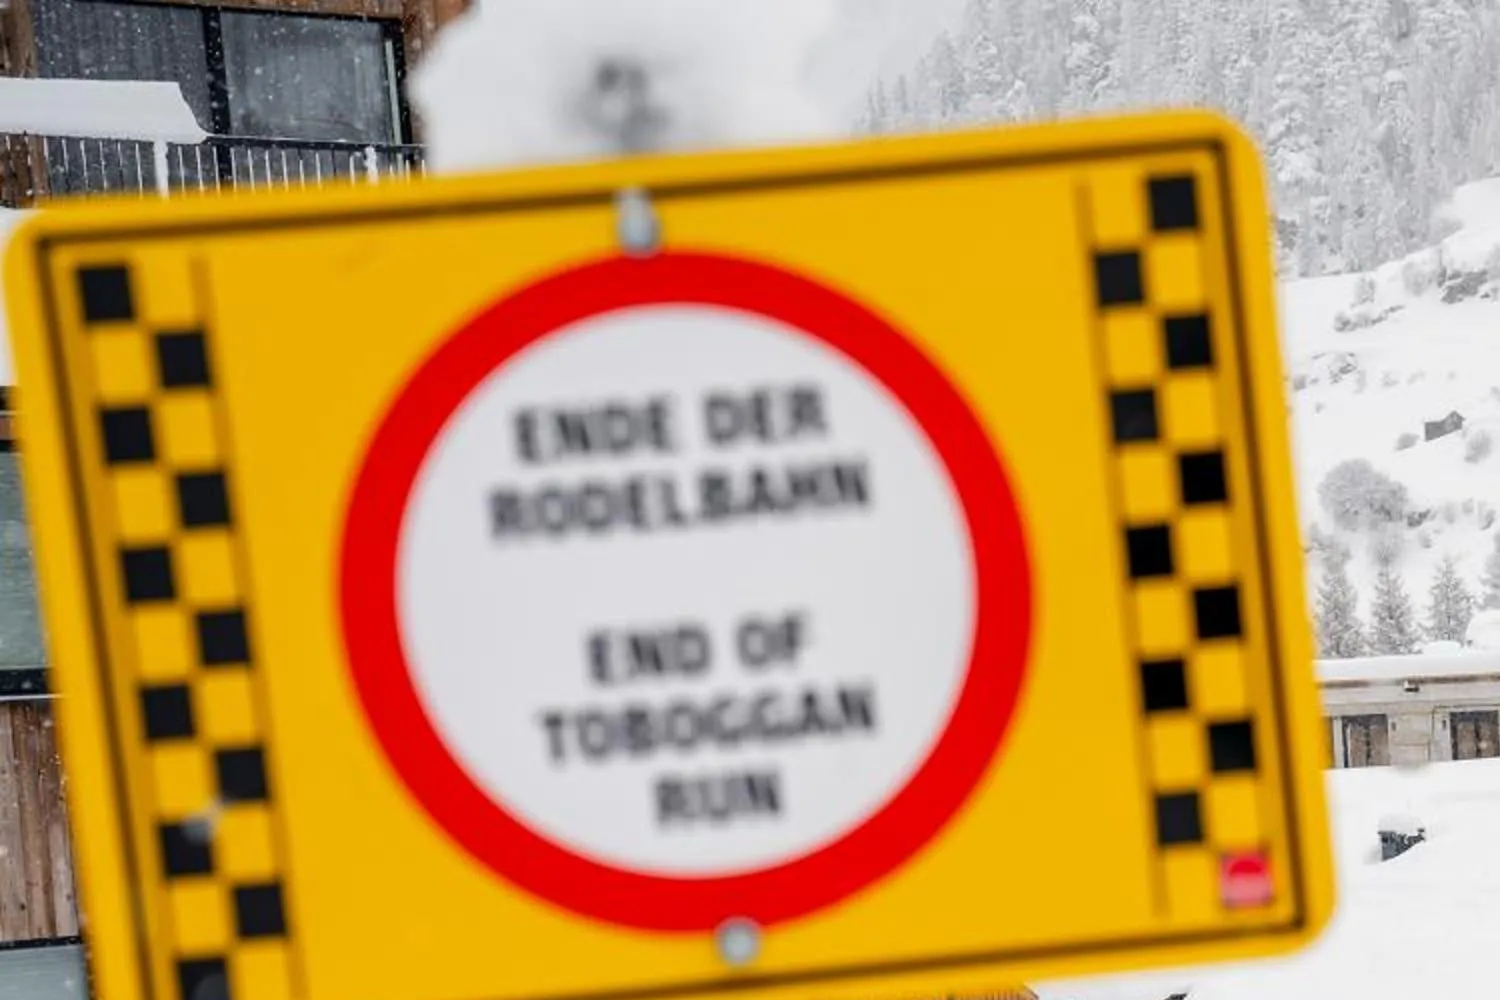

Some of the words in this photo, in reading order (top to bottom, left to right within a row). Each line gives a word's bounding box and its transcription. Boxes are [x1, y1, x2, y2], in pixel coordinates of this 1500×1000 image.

[512, 396, 674, 466] ENDE
[702, 384, 828, 450] DER
[487, 460, 871, 540] RODELBAHN
[585, 623, 713, 688] END
[735, 611, 806, 671] OF
[539, 684, 877, 764] TOBOGGAN
[653, 771, 784, 827] RUN
